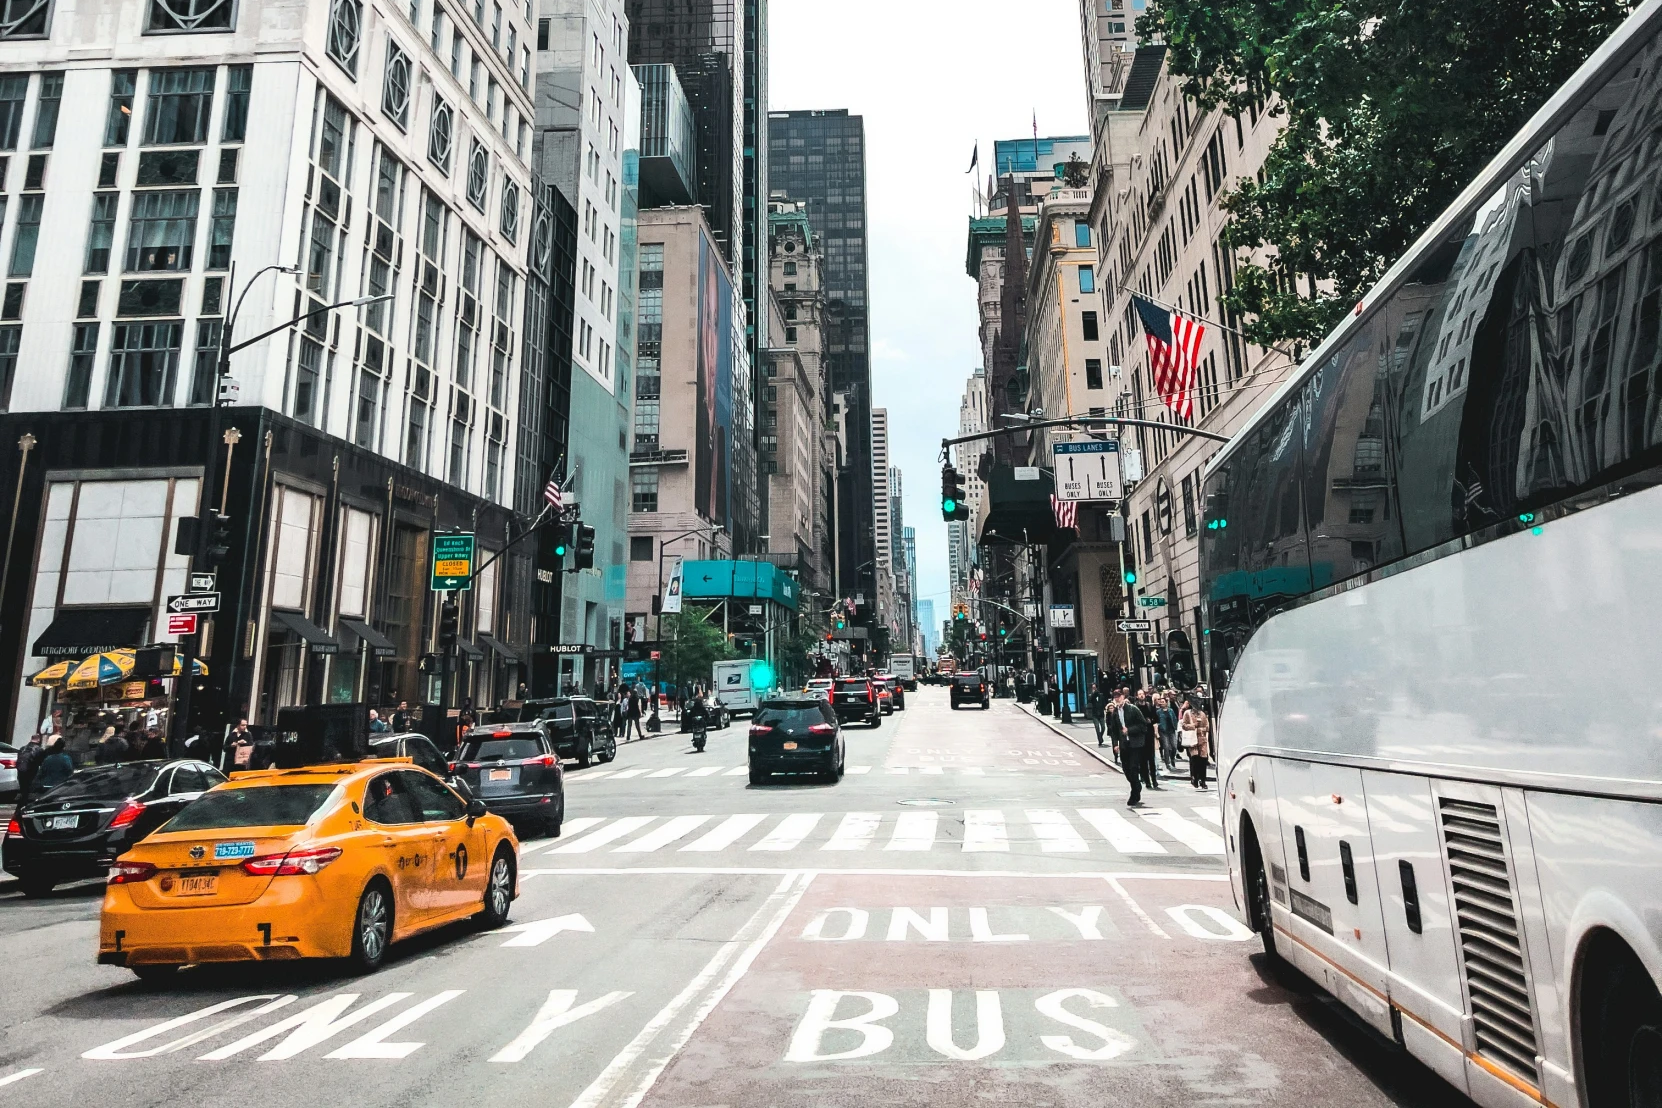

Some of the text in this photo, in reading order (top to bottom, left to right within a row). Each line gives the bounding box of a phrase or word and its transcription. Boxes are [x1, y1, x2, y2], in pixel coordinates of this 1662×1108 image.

[1068, 443, 1103, 452] BUS LANES
[1065, 482, 1081, 490] BUSES
[1097, 481, 1113, 489] BUSES
[537, 569, 553, 583] HUBLOT
[174, 598, 213, 608] ONE WAY
[40, 645, 78, 655] BERGDORF
[550, 645, 581, 653] HUBLOT
[1008, 749, 1076, 758] ONLY
[1023, 758, 1082, 766] BUS
[801, 906, 1105, 941] ONLY
[82, 989, 637, 1062] ONLY
[783, 988, 1139, 1061] BUS
